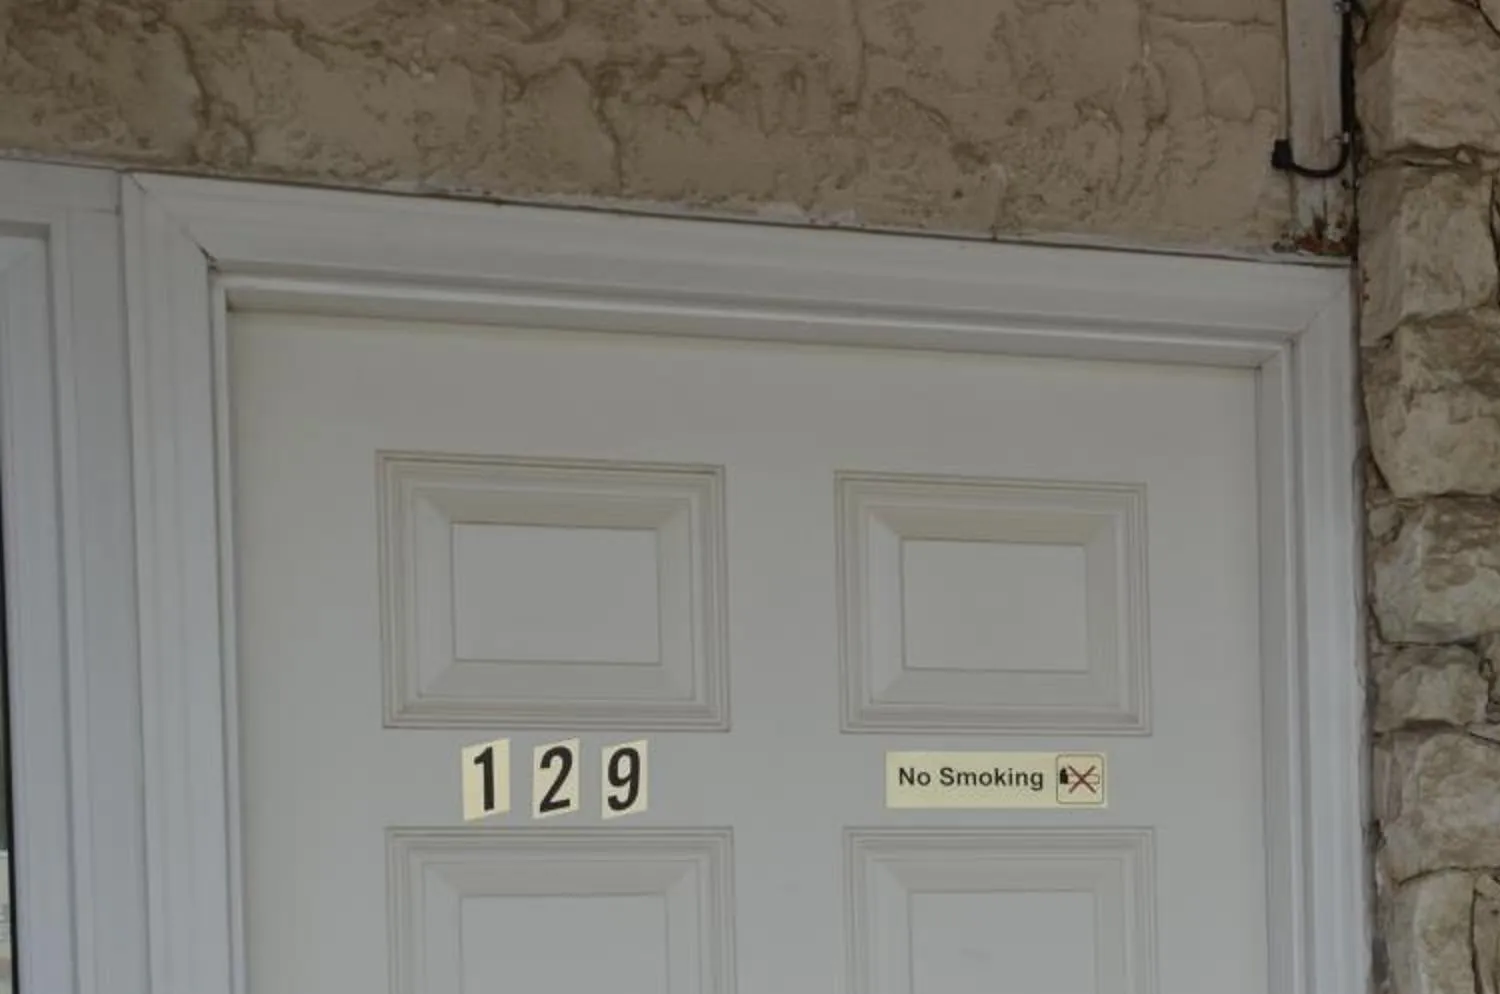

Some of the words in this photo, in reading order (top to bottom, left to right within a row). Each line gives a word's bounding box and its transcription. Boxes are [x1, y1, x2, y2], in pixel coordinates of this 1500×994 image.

[473, 745, 641, 813] 129
[898, 766, 932, 787] No
[938, 765, 1044, 792] Smoking
